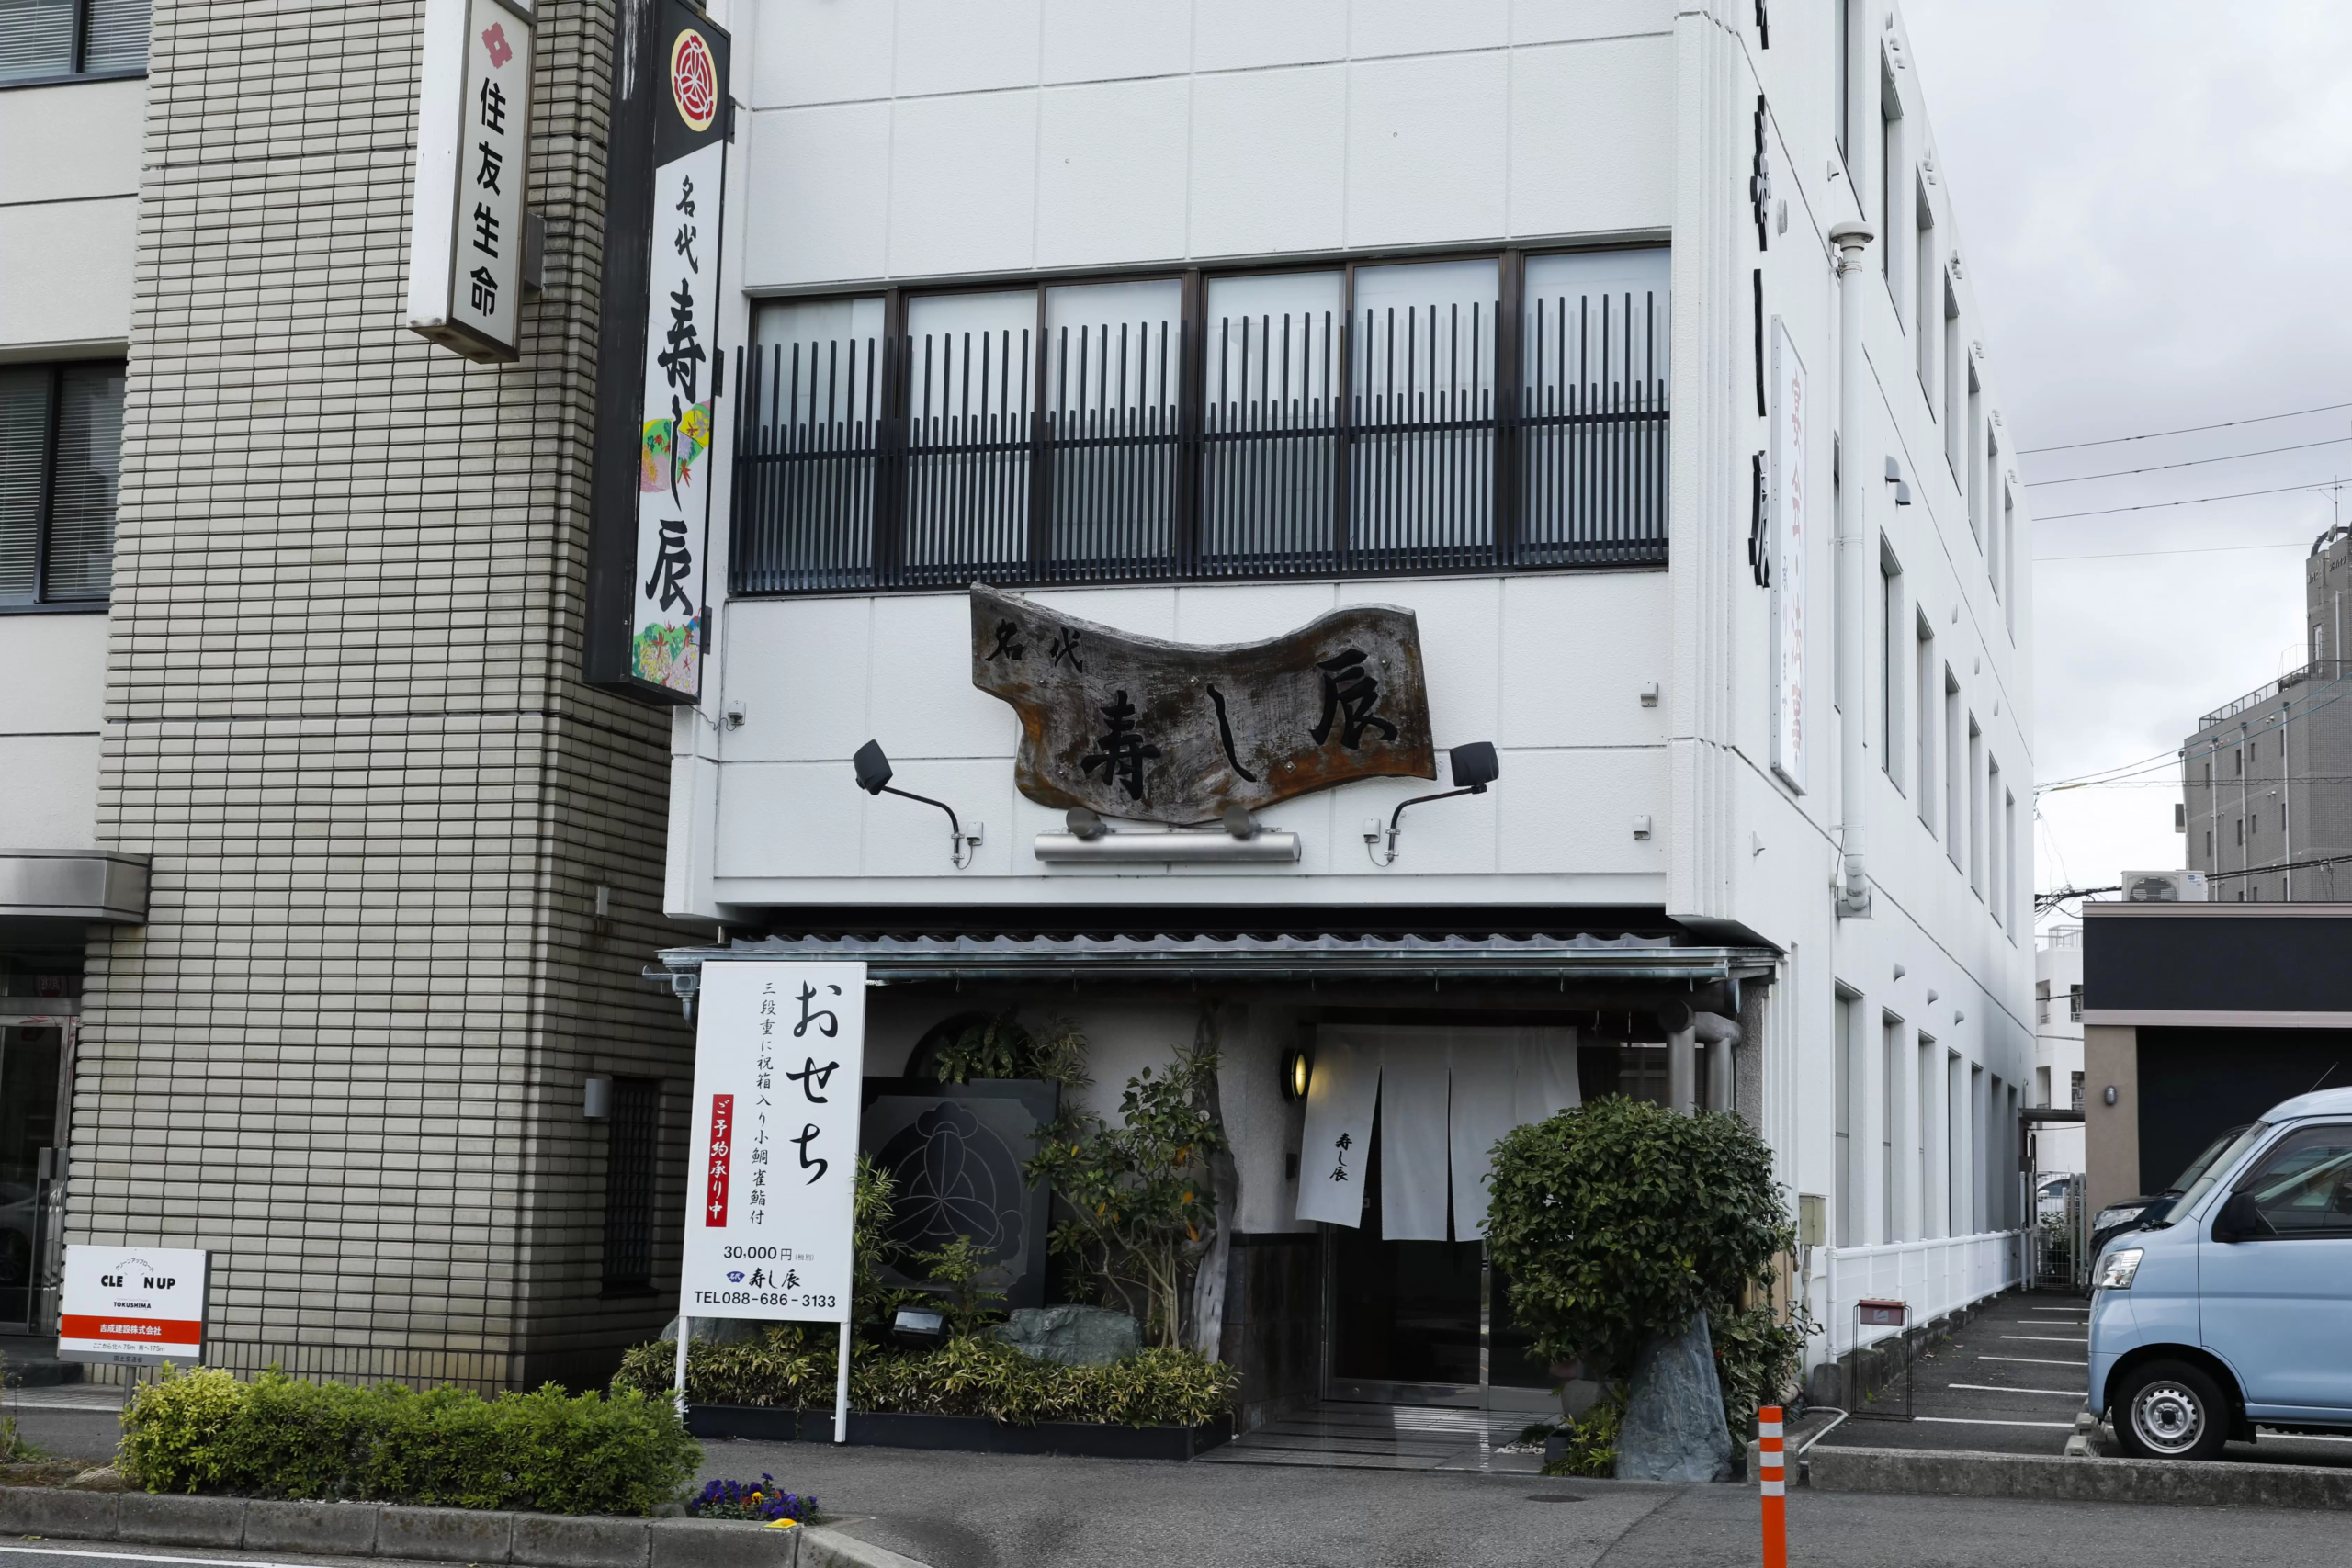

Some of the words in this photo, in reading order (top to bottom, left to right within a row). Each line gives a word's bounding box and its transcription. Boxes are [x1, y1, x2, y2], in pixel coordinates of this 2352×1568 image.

[469, 77, 506, 318] 住友生命
[985, 618, 1083, 673] 名代
[1080, 648, 1398, 801] 寿し辰
[786, 980, 842, 1185] おせち
[708, 1100, 730, 1220] ご予約承り中
[1329, 1133, 1352, 1182] 寿し辰
[749, 1267, 801, 1290] 寿し辰
[99, 1324, 162, 1336] 吉成建設株式会社
[113, 1355, 142, 1363] 国土交通省
